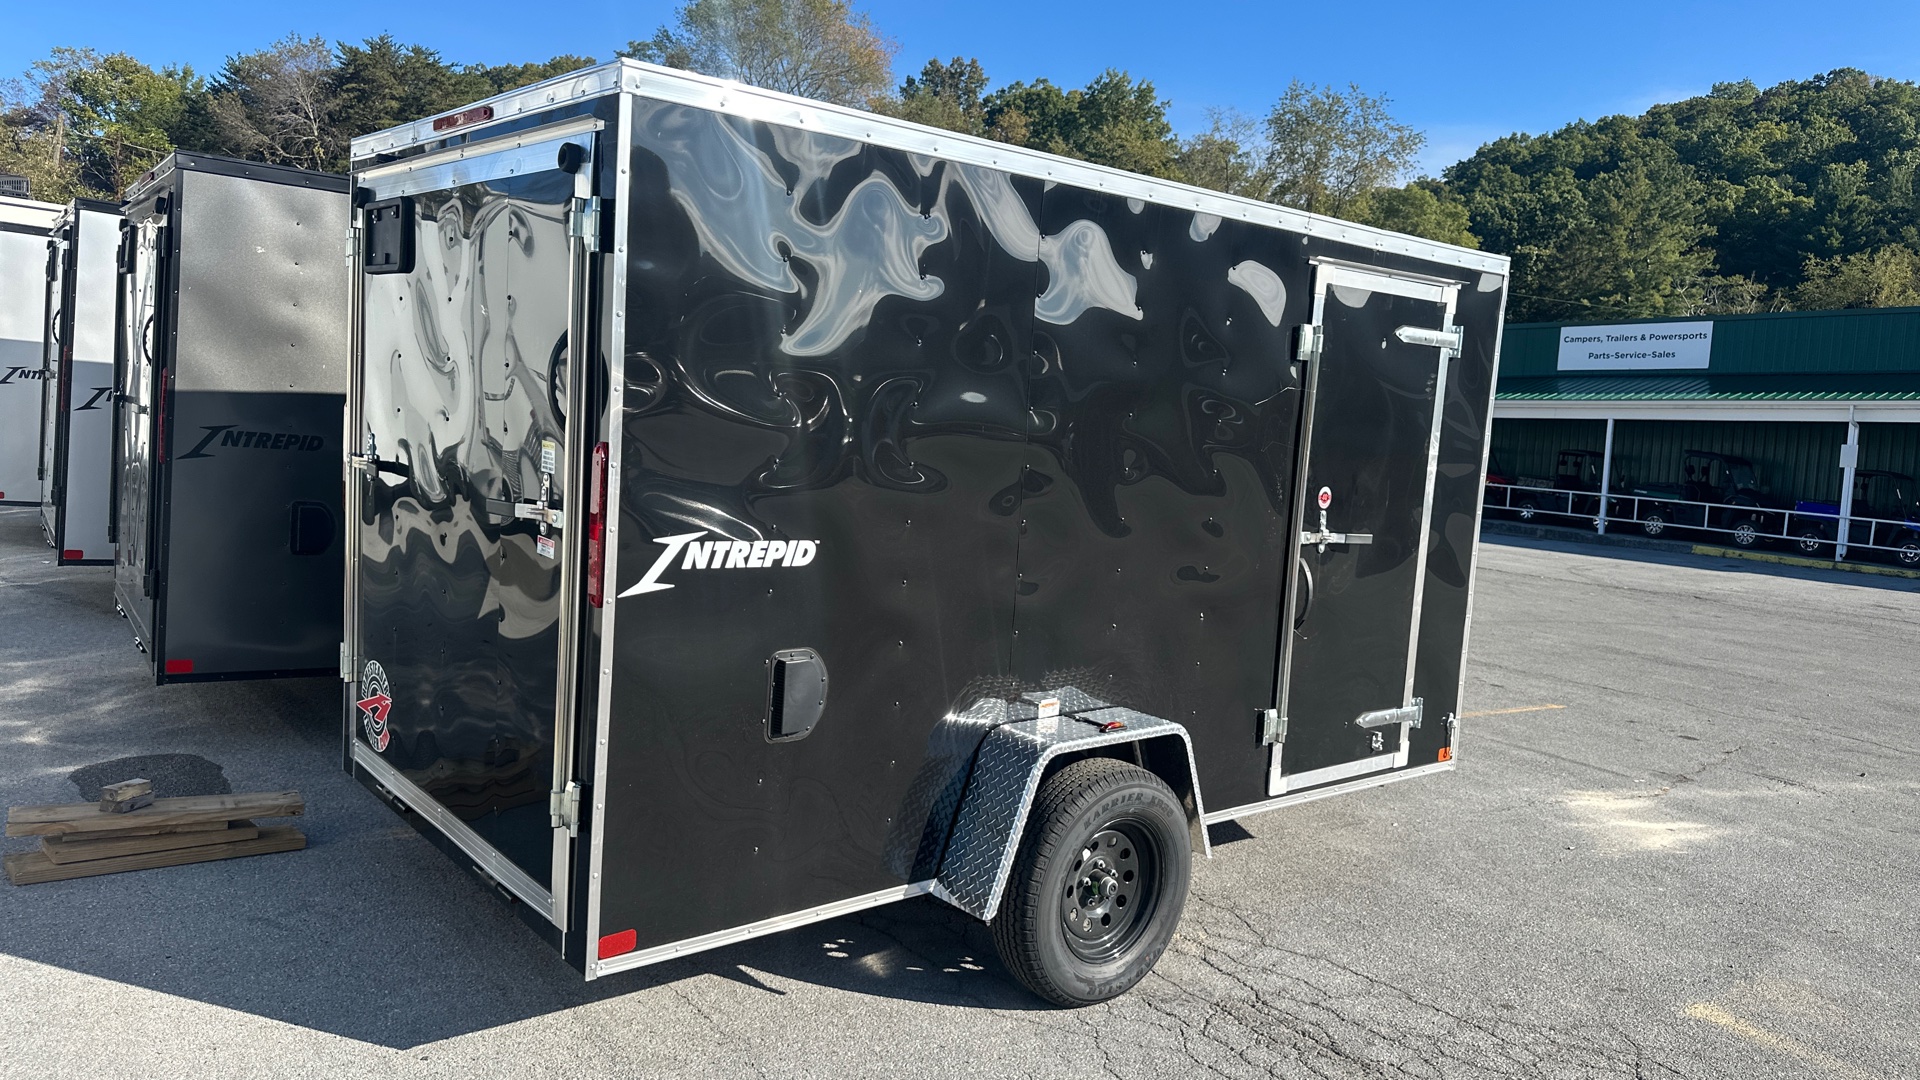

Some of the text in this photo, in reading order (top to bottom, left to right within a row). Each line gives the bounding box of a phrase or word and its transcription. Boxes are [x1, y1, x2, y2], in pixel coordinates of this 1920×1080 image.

[1563, 332, 1708, 344] Campers, Trailers & Powersports
[1588, 351, 1676, 360] Parts-Service-Sales
[0, 366, 43, 385] INT
[175, 424, 324, 460] INTREPID
[617, 531, 817, 598] INTREPID
[1083, 793, 1144, 831] KARRIER
